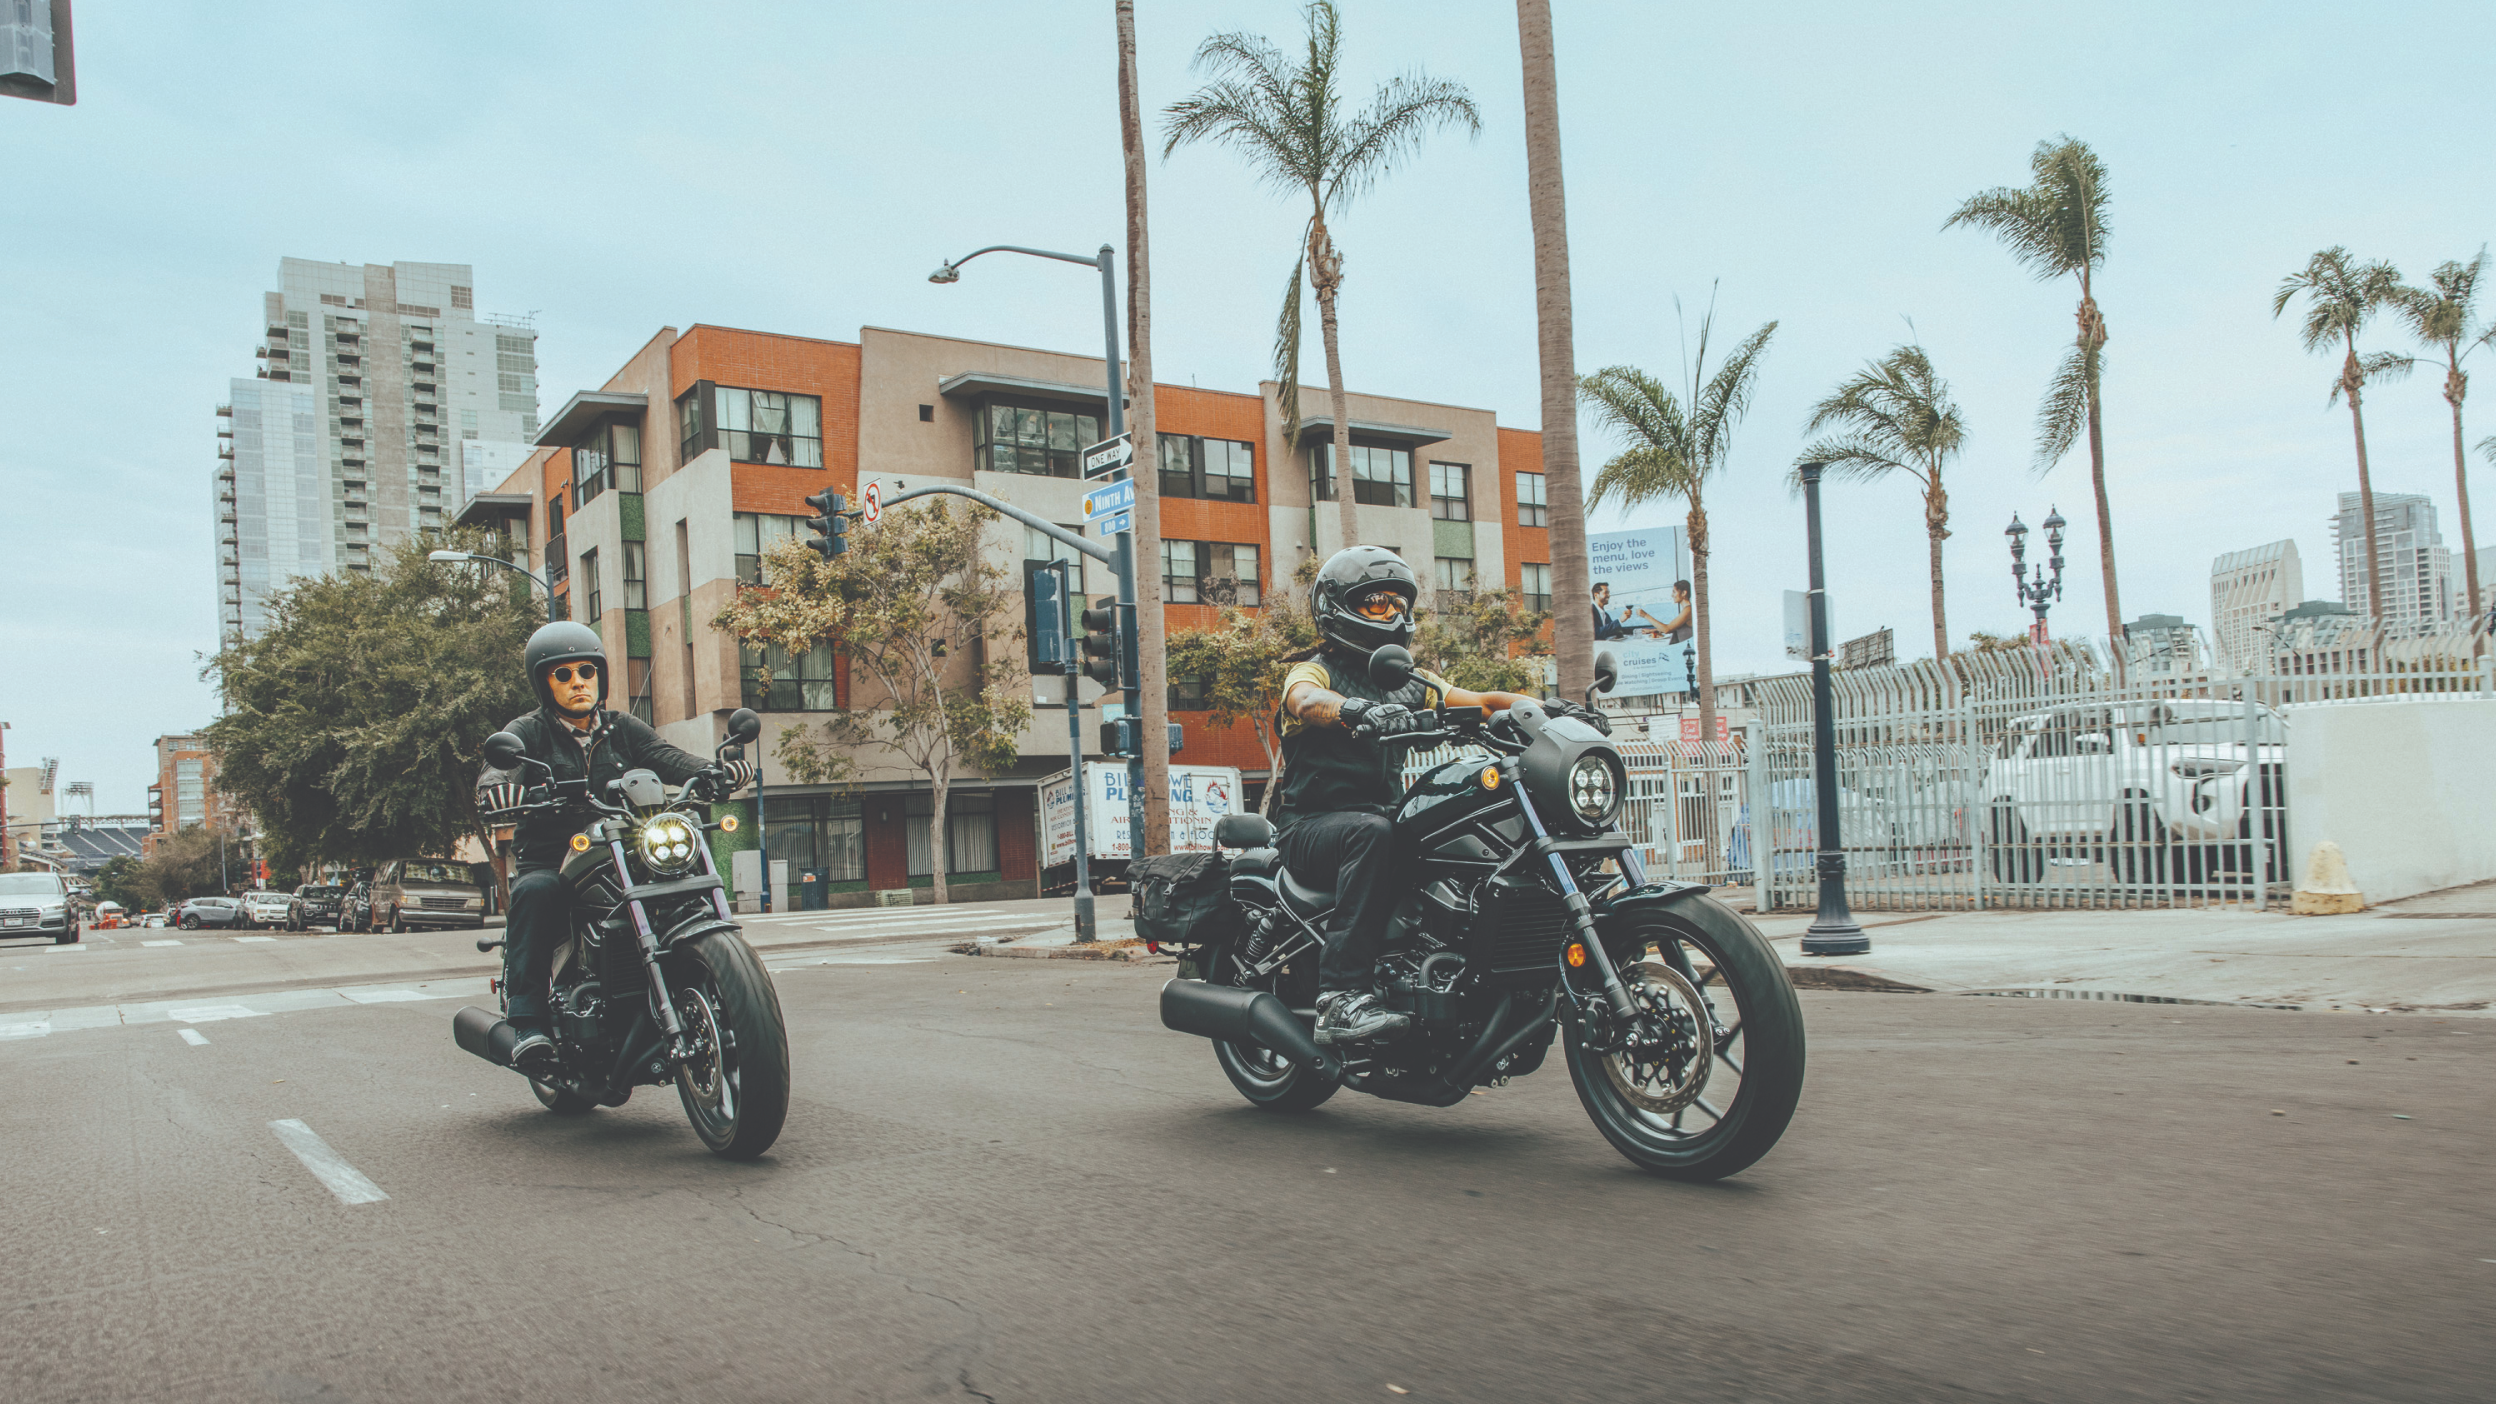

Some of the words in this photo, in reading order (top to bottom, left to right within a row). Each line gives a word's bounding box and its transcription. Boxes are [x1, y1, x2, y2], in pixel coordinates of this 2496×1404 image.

[1091, 453, 1104, 468] ONE
[1106, 447, 1120, 461] WAY
[1094, 491, 1121, 512] NINTH
[1591, 541, 1624, 553] Enjoy
[1626, 538, 1647, 548] the
[1631, 550, 1655, 560] love
[1593, 565, 1612, 575] the
[1615, 562, 1649, 572] views
[1623, 650, 1639, 658] city
[1623, 657, 1657, 666] cruises
[1104, 772, 1128, 787] BIL
[1111, 816, 1130, 824] AIR
